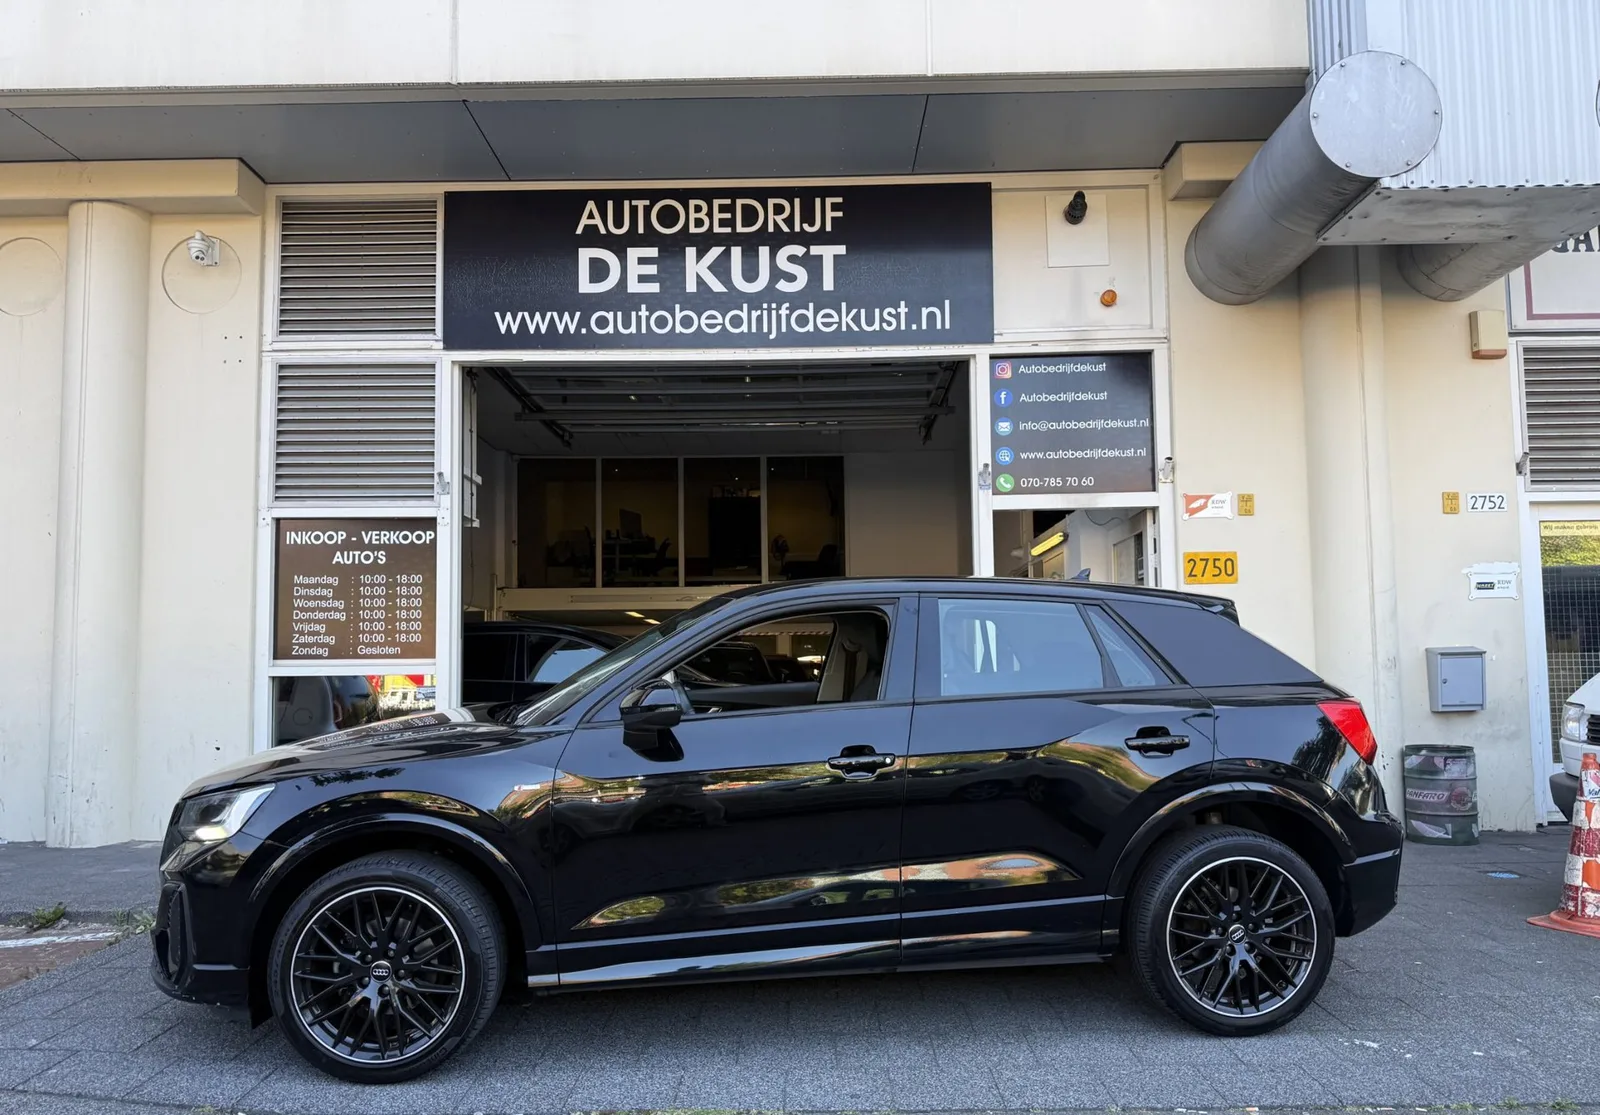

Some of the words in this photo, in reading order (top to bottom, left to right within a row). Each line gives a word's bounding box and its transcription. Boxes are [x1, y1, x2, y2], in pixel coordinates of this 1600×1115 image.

[575, 197, 844, 236] AUTOBEDRIJF
[578, 248, 661, 294] DE
[685, 244, 847, 294] KUST
[494, 299, 951, 339] www.autobedrijfdekust.nl
[1018, 362, 1107, 375] Autobedrijfdekust
[1019, 391, 1108, 404] Autobedrijfdekust
[1019, 418, 1150, 432] info@autobedrijfdekust.nl
[1019, 447, 1147, 461] www.autobedrijfdekust.nl
[1020, 477, 1063, 488] 070-785
[1065, 477, 1079, 487] 70
[1081, 477, 1095, 487] 60
[1470, 494, 1505, 511] 2752
[286, 531, 347, 545] INKOOP
[361, 531, 435, 545] VERKOOP
[332, 550, 387, 565] AUTO'S
[1187, 557, 1235, 578] 2750
[293, 575, 339, 586] Maandag
[359, 574, 387, 584] 10:00
[396, 574, 423, 584] 18:00
[293, 586, 333, 597] Dinsdag
[359, 585, 387, 595] 10:00
[396, 585, 423, 595] 18:00
[293, 598, 345, 609] Woensdag
[359, 597, 387, 607] 10:00
[396, 597, 423, 607] 18:00
[293, 610, 346, 621] Donderdag
[358, 609, 386, 619] 10:00
[395, 609, 422, 619] 18:00
[292, 622, 326, 633] Vrijdag
[358, 621, 386, 631] 10:00
[395, 621, 422, 631] 18:00
[292, 634, 336, 645] Zaterdag
[358, 632, 386, 642] 10:00
[395, 632, 422, 642] 18:00
[291, 646, 329, 657] Zondag
[357, 645, 401, 655] Gesloten
